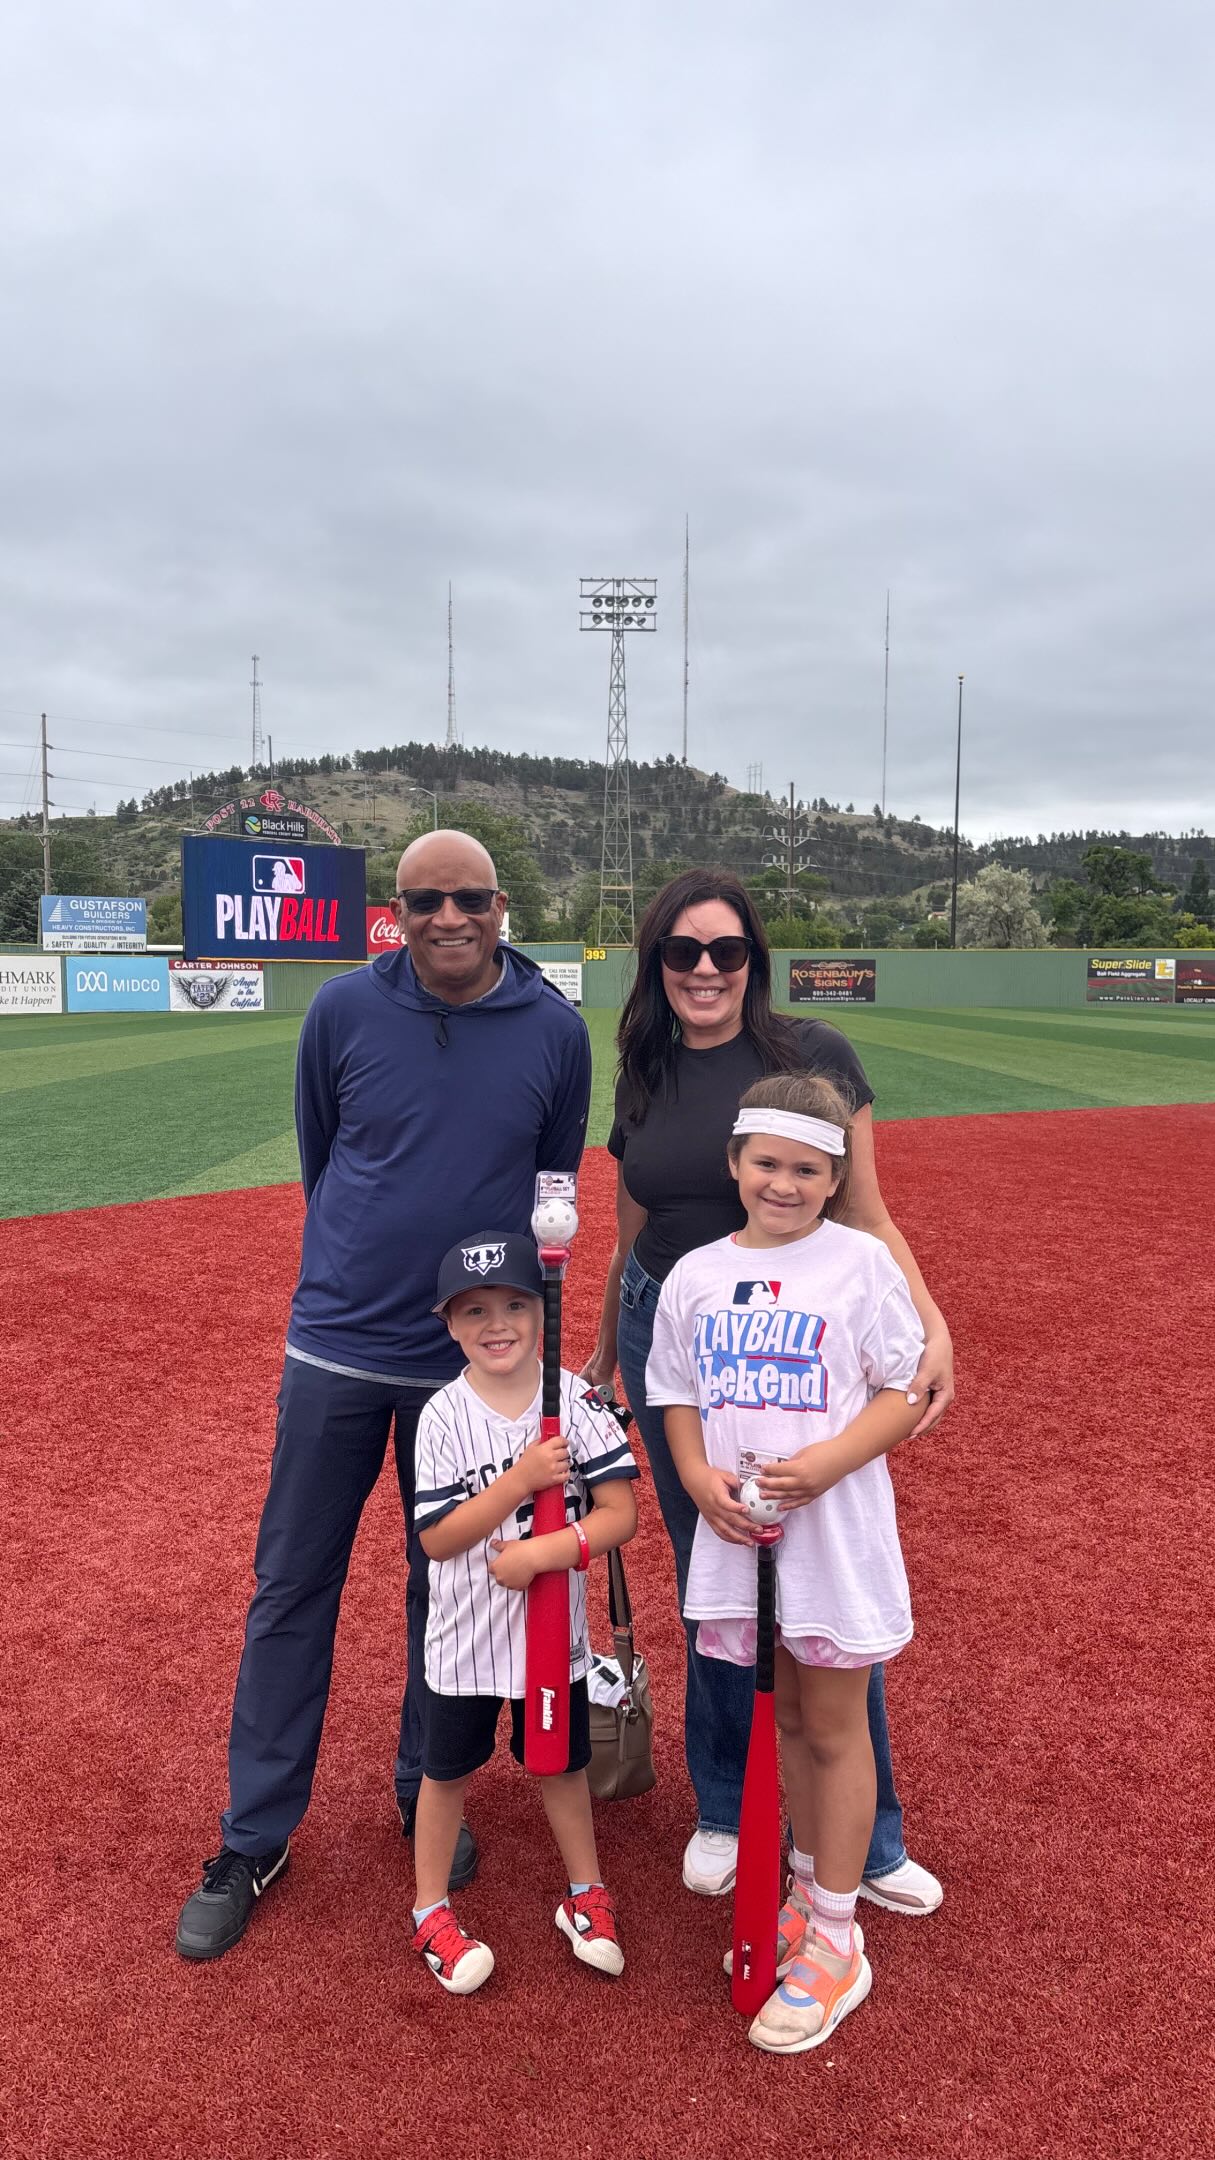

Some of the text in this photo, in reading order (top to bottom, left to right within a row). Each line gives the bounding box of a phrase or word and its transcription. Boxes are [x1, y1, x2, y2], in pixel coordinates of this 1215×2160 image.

[205, 798, 256, 831] POST 22
[262, 819, 305, 833] Black Hills
[70, 900, 142, 912] GUSTAFSON
[83, 911, 130, 920] BUILDERS
[117, 942, 145, 950] INTEGRITY
[586, 950, 606, 960] 393
[174, 961, 259, 970] CARTER JOHNSON
[1091, 959, 1152, 970] Super Slide
[113, 979, 160, 992] MIDCO
[233, 976, 259, 989] Angel
[11, 996, 19, 1005] It
[230, 997, 262, 1009] Outfield
[541, 1687, 555, 1731] Franklin
